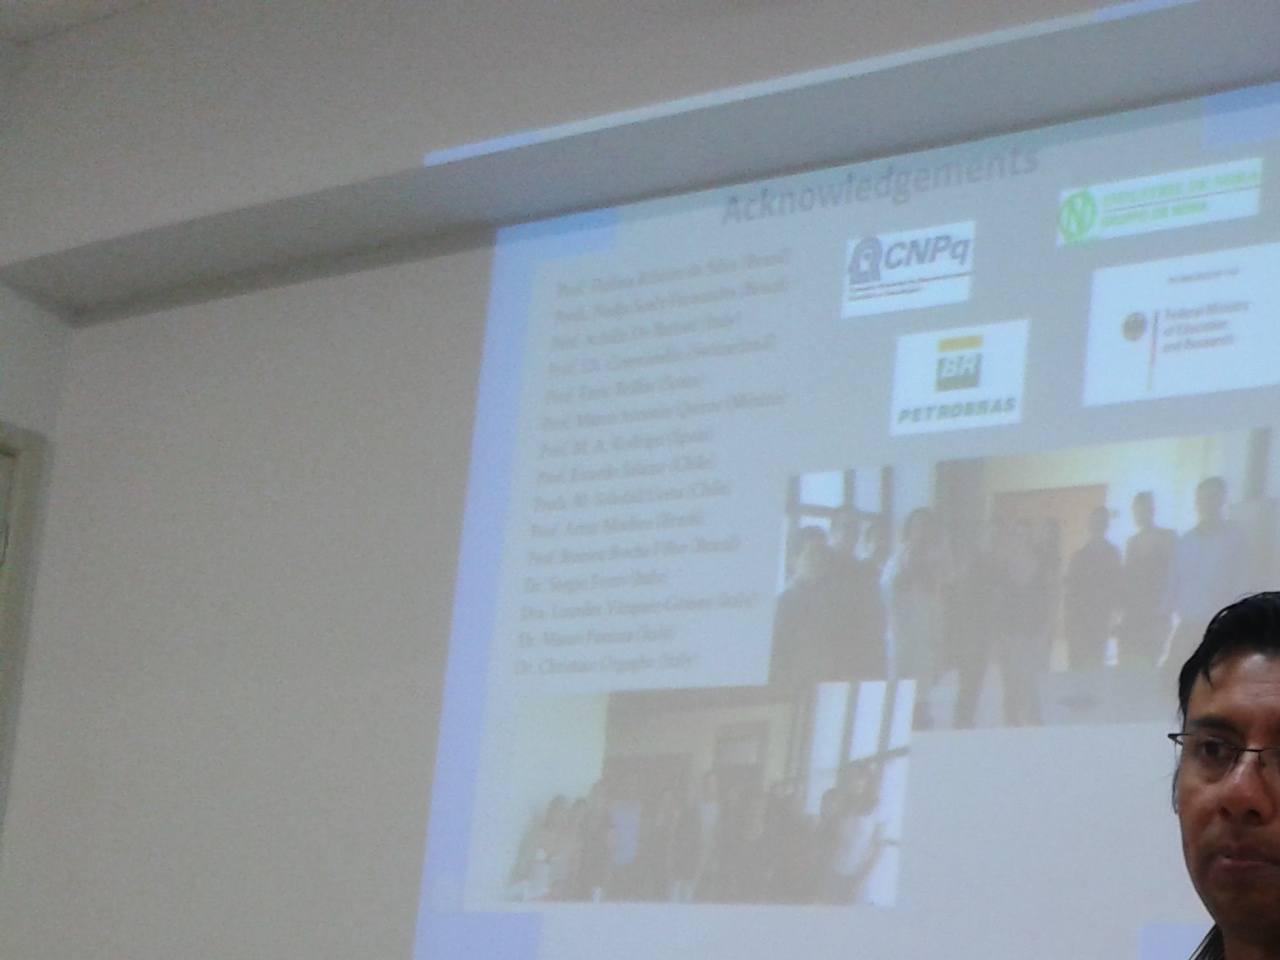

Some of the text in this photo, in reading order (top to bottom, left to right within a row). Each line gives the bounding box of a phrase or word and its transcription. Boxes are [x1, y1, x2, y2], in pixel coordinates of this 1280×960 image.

[720, 146, 1038, 226] Acknowledgements
[884, 234, 971, 270] CNPq
[897, 397, 1017, 424] PETROBRAS
